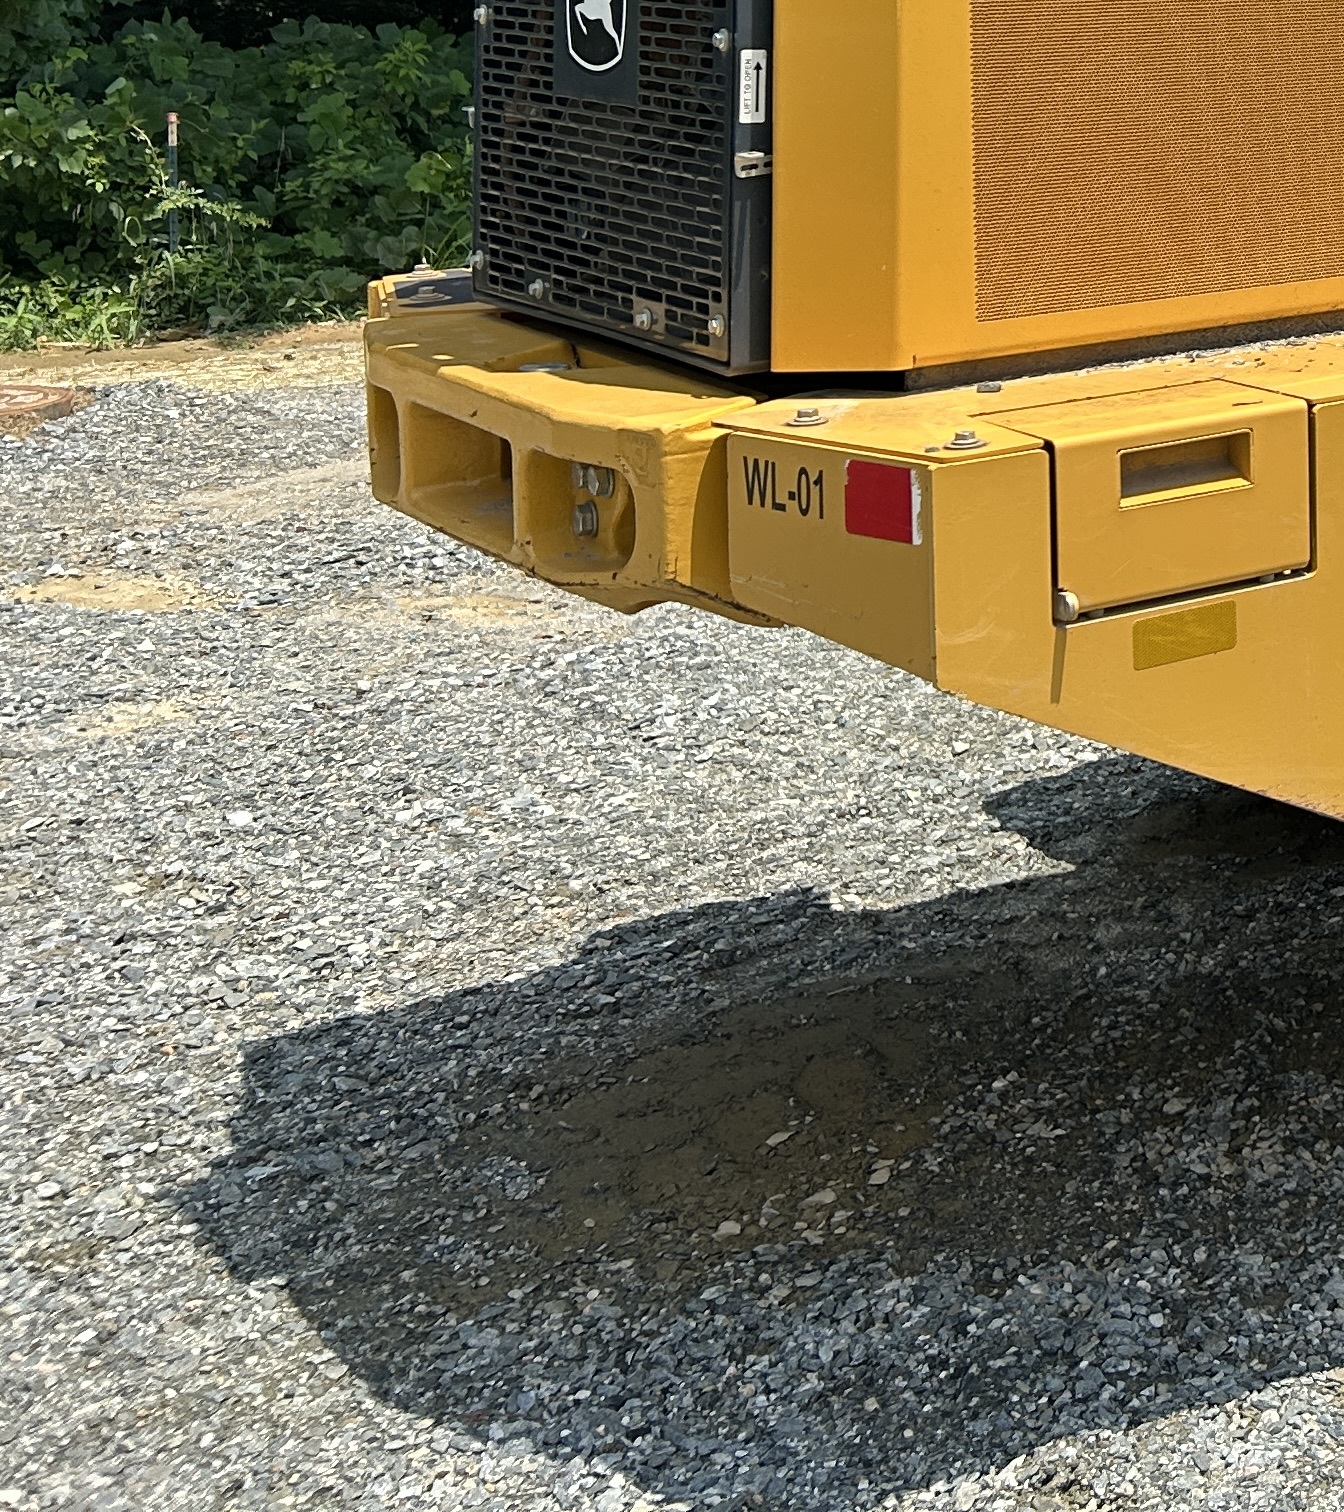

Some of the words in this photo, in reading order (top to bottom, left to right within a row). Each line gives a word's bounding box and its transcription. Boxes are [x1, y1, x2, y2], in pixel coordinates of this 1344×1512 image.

[744, 59, 752, 81] OPEN
[744, 84, 751, 94] TO
[743, 455, 824, 520] WL-01
